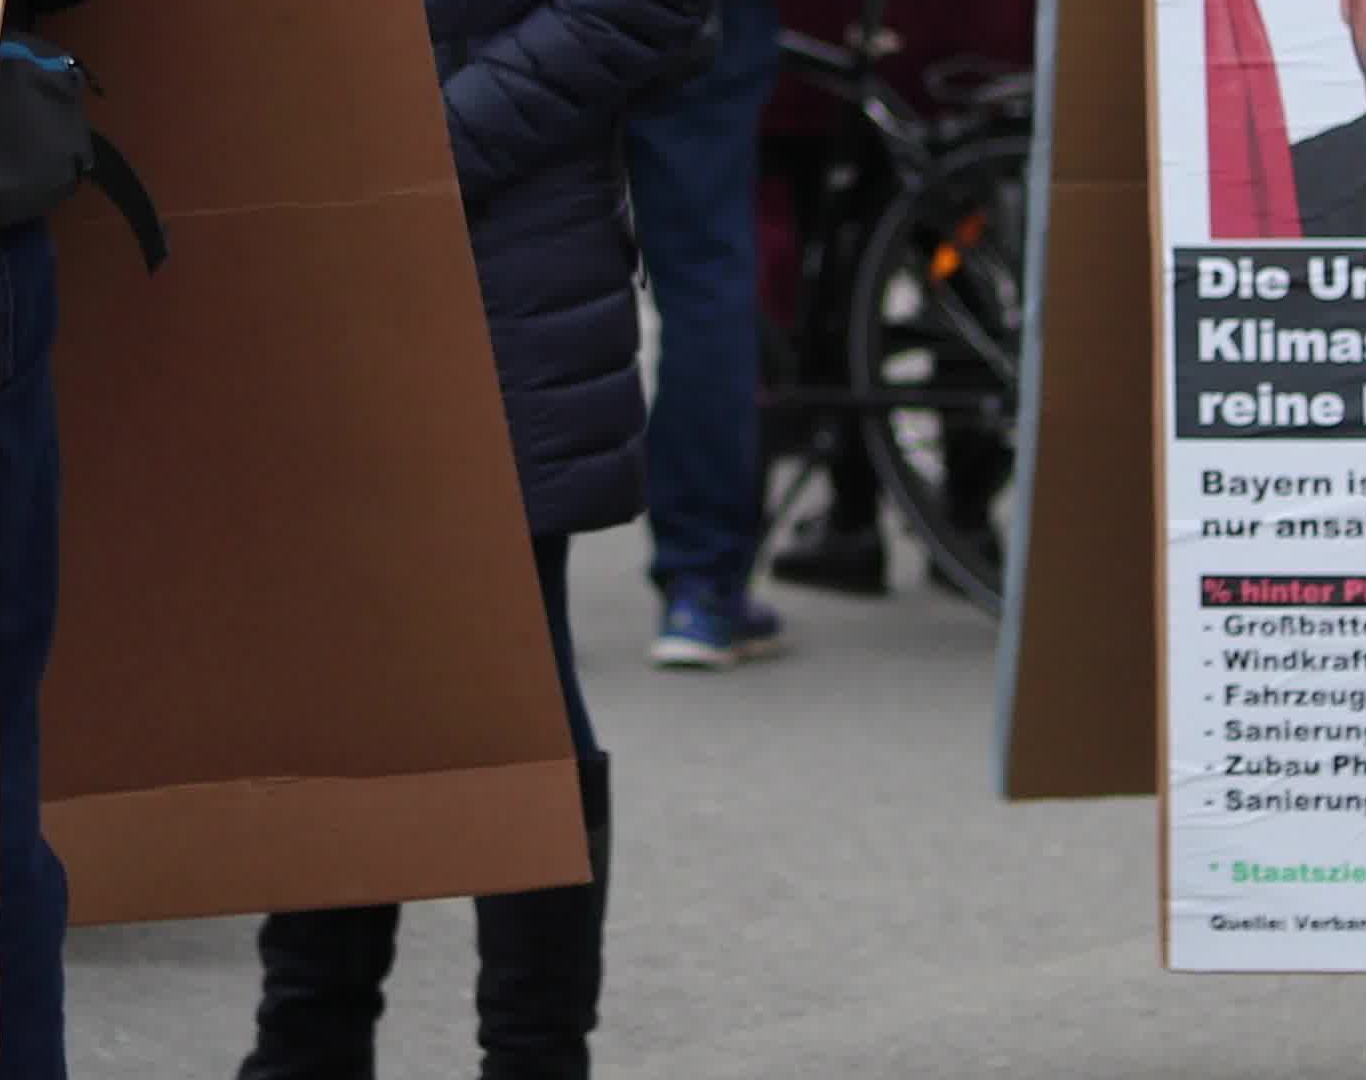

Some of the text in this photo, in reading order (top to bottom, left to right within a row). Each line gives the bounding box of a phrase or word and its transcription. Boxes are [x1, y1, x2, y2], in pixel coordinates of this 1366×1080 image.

[1198, 258, 1289, 301] Die
[1200, 387, 1344, 425] reine
[1203, 470, 1331, 502] Bayern
[1202, 520, 1260, 540] nur
[1204, 578, 1234, 602] %
[1240, 579, 1336, 602] hinter
[1224, 755, 1320, 776] Zubau
